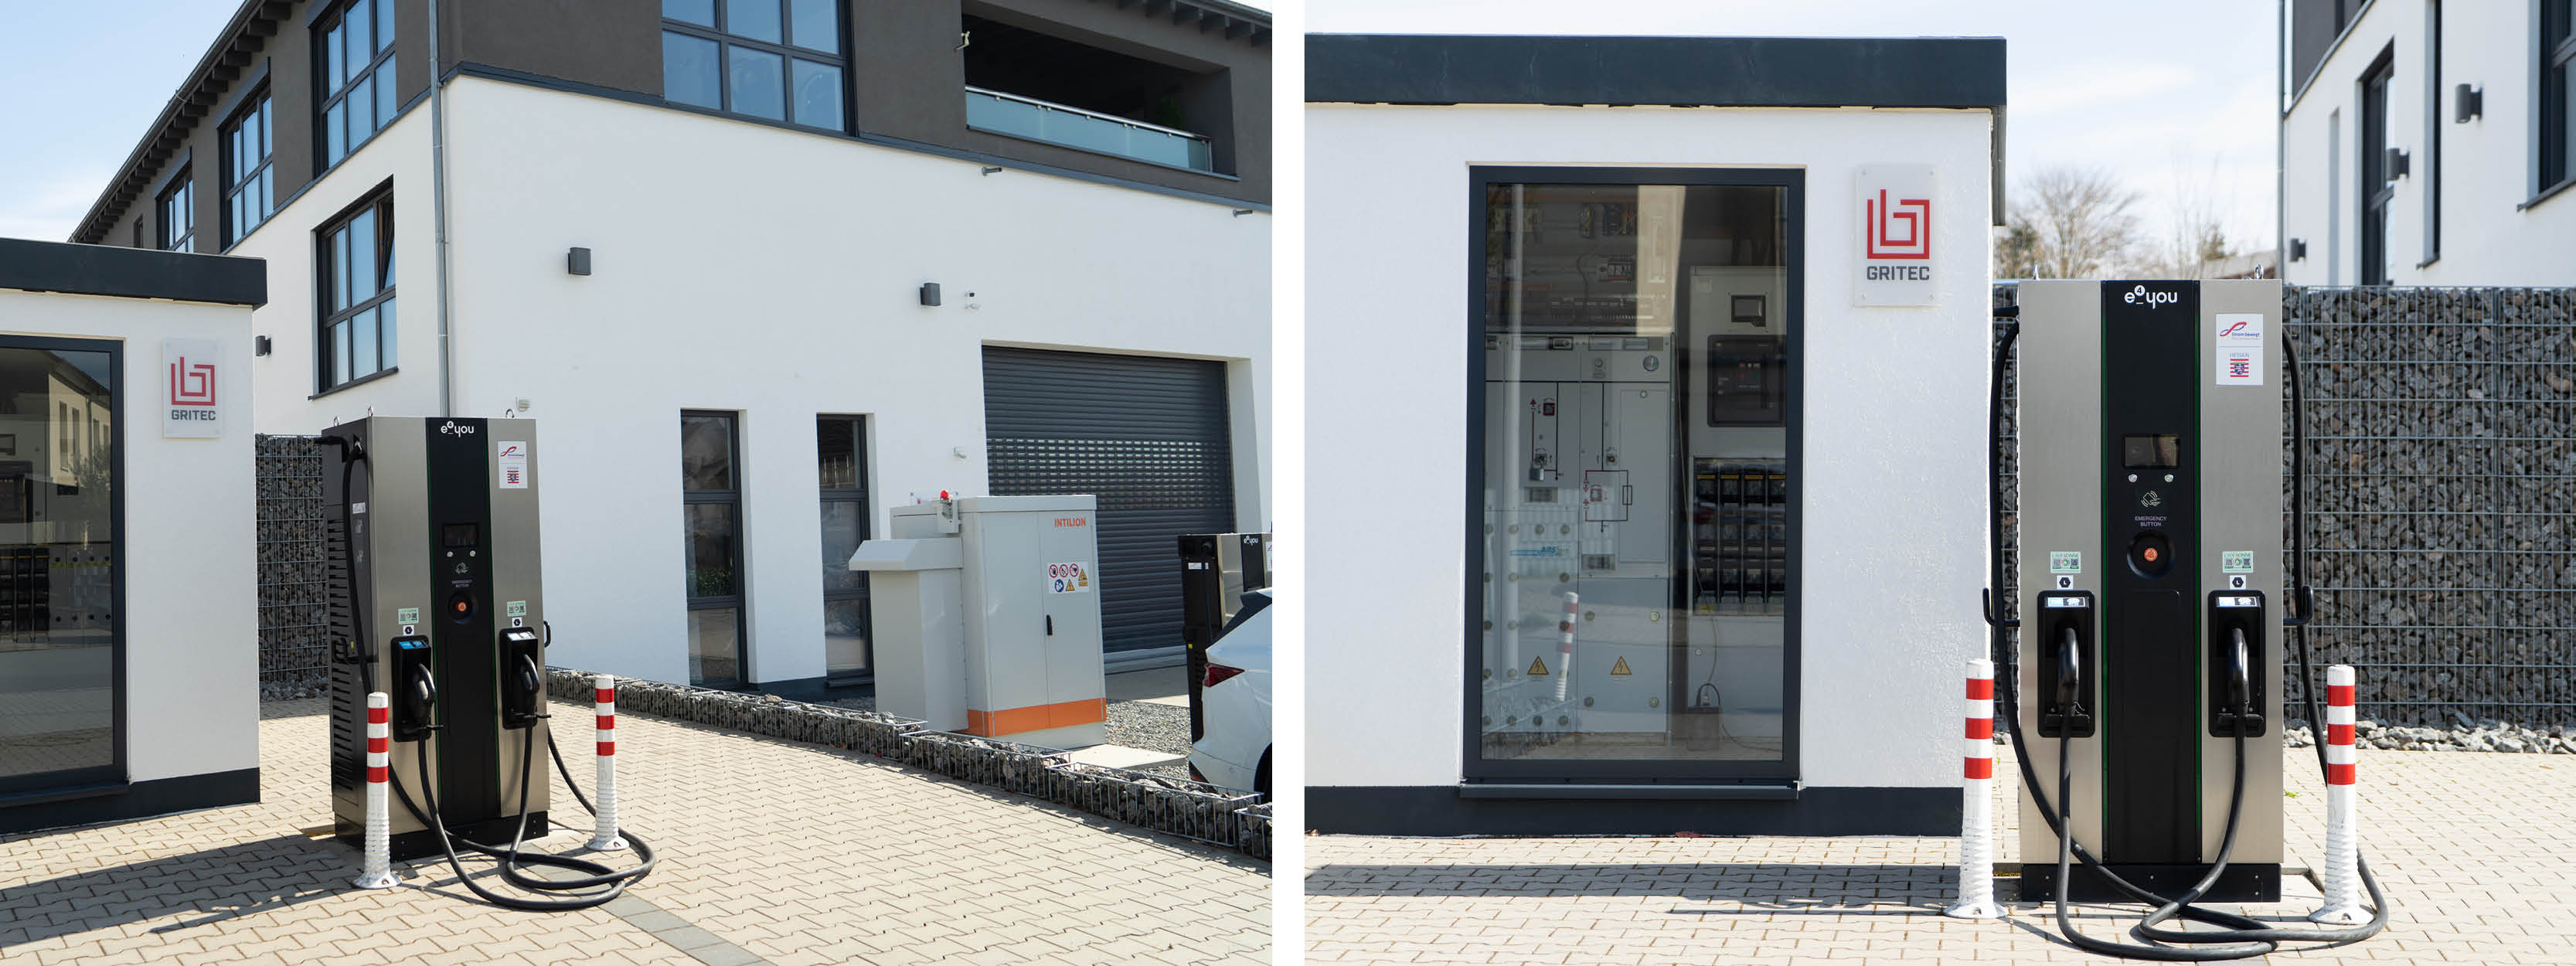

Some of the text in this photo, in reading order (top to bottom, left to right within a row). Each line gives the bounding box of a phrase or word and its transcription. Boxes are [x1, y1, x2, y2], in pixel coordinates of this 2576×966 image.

[1866, 265, 1930, 281] GRITEC
[171, 410, 216, 420] GRITEC
[1054, 517, 1087, 527] INTILION
